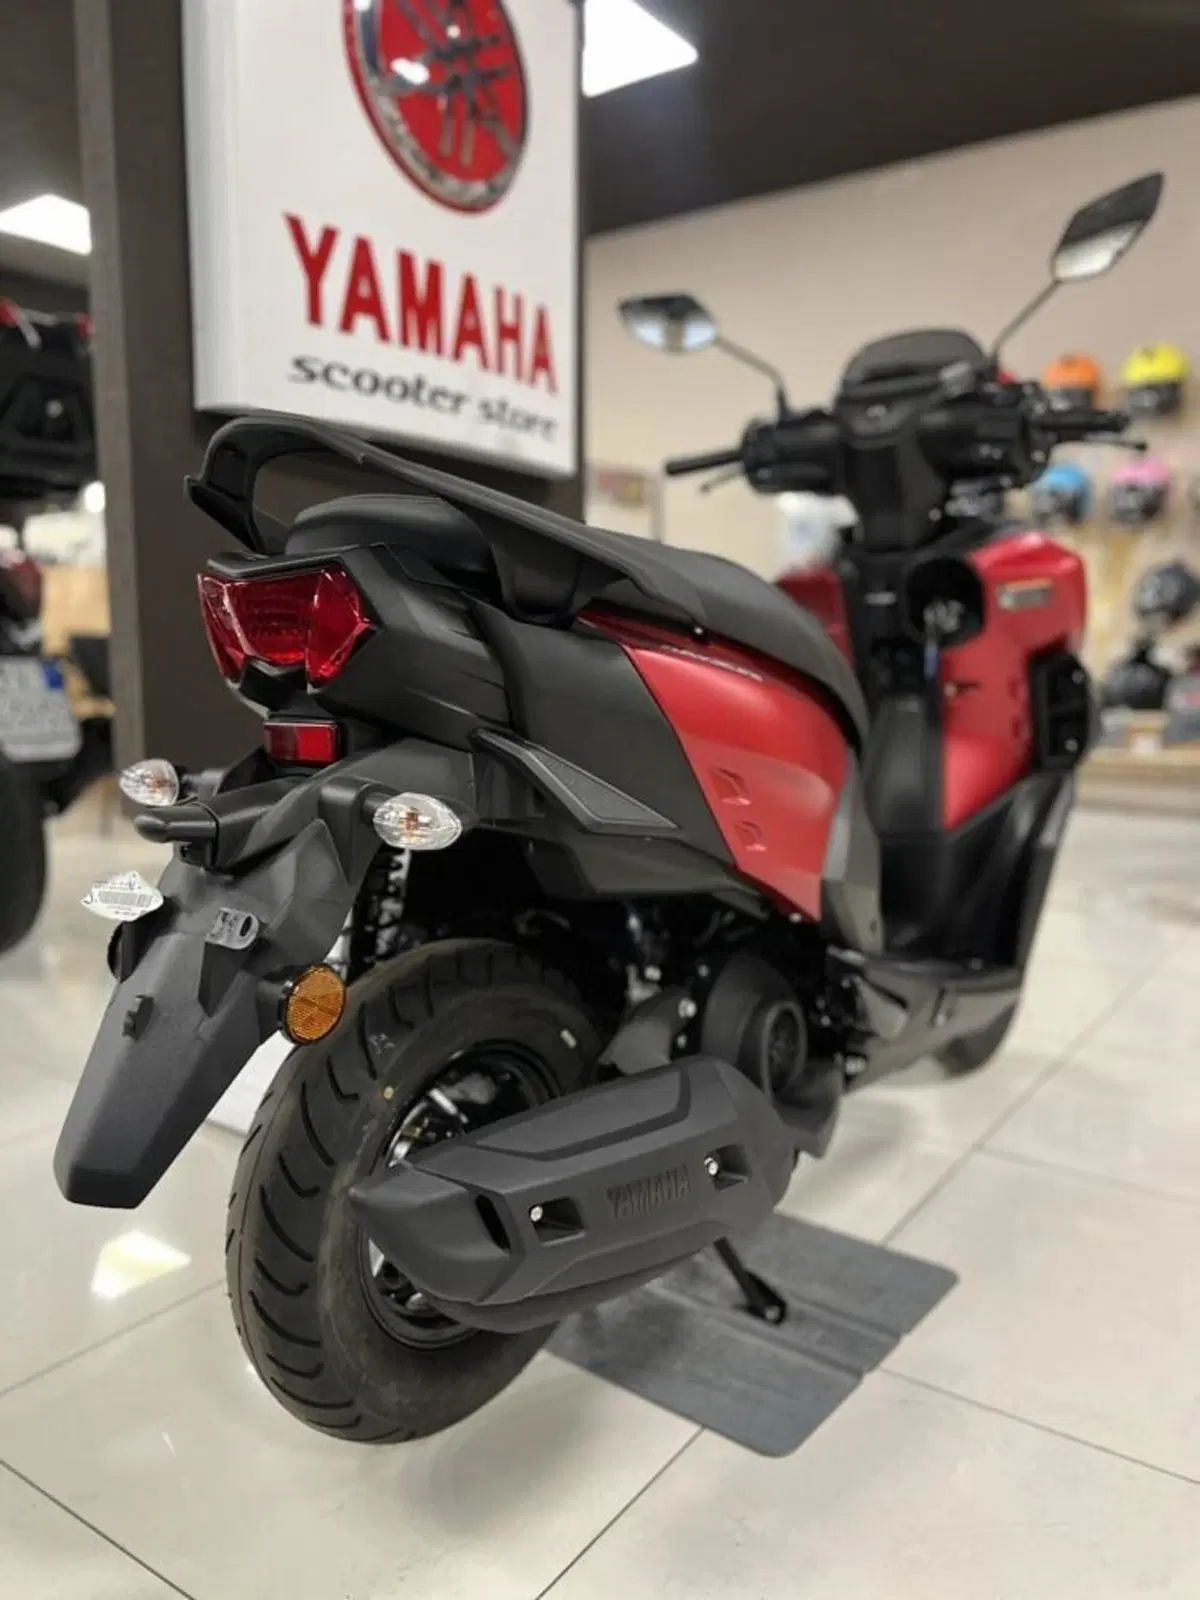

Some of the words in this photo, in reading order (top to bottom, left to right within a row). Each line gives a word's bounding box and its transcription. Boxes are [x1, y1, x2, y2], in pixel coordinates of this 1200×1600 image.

[284, 212, 558, 396] YAMAHA
[289, 355, 470, 415] scooter
[478, 398, 558, 441] store
[606, 1165, 690, 1219] YAMAHA
